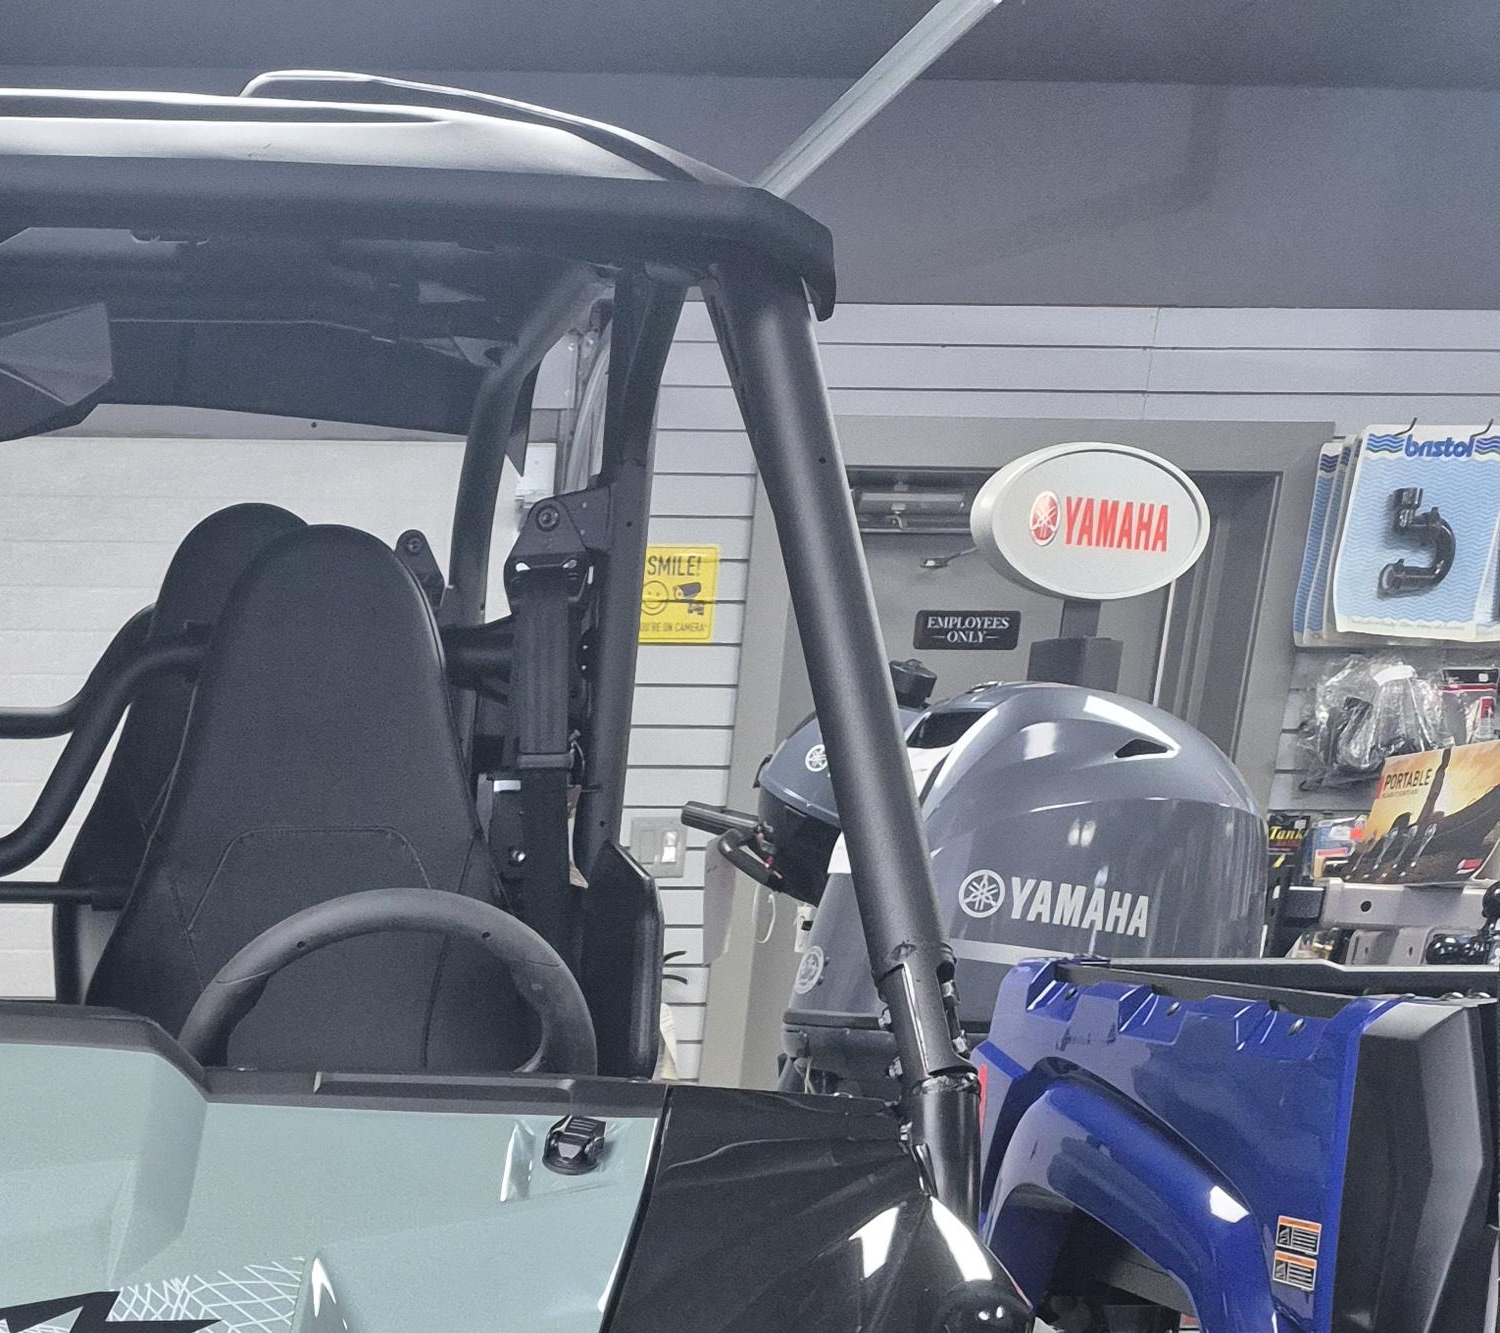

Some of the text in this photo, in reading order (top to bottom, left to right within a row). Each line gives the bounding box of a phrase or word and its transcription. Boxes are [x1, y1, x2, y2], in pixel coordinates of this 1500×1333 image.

[1404, 433, 1474, 458] bristol
[1065, 496, 1169, 552] YAMAHA
[647, 555, 702, 577] SMILE!
[927, 616, 1010, 629] EMPLOYEES
[946, 631, 987, 643] ONLY
[1383, 768, 1432, 791] PORTABLE
[1269, 826, 1304, 840] Tank
[1011, 877, 1149, 938] YAMAHA
